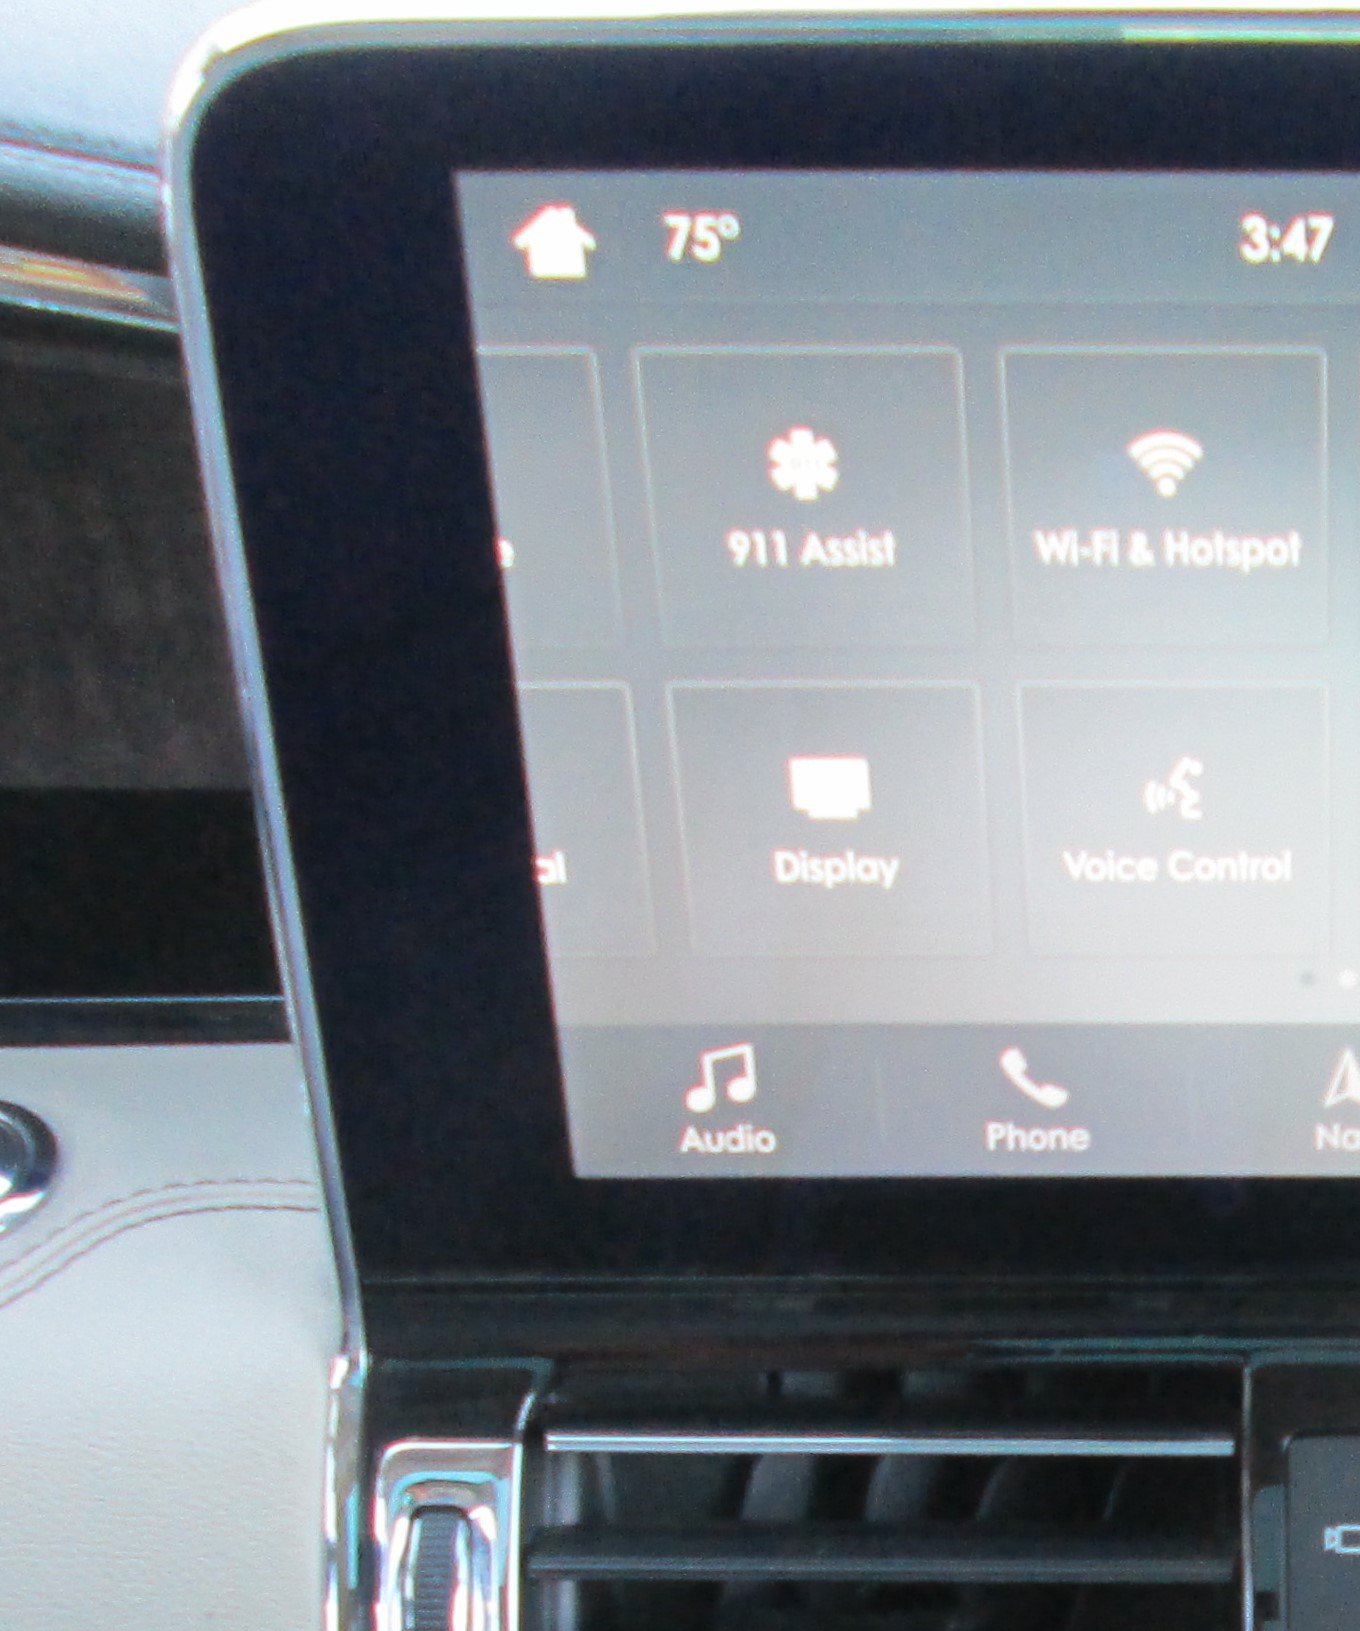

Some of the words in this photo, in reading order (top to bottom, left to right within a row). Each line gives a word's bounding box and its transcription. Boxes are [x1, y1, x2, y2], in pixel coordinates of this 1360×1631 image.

[1240, 214, 1333, 264] 3:47
[728, 530, 788, 568] 911
[800, 530, 896, 568] Assist
[1034, 530, 1118, 567] Wi-Fi
[1129, 531, 1155, 567] &
[1165, 530, 1301, 572] Hotspot
[773, 850, 900, 889] Display
[1063, 850, 1160, 883] Voice
[1168, 850, 1293, 883] Control
[680, 1124, 777, 1155] Audio
[985, 1122, 1091, 1152] Phone
